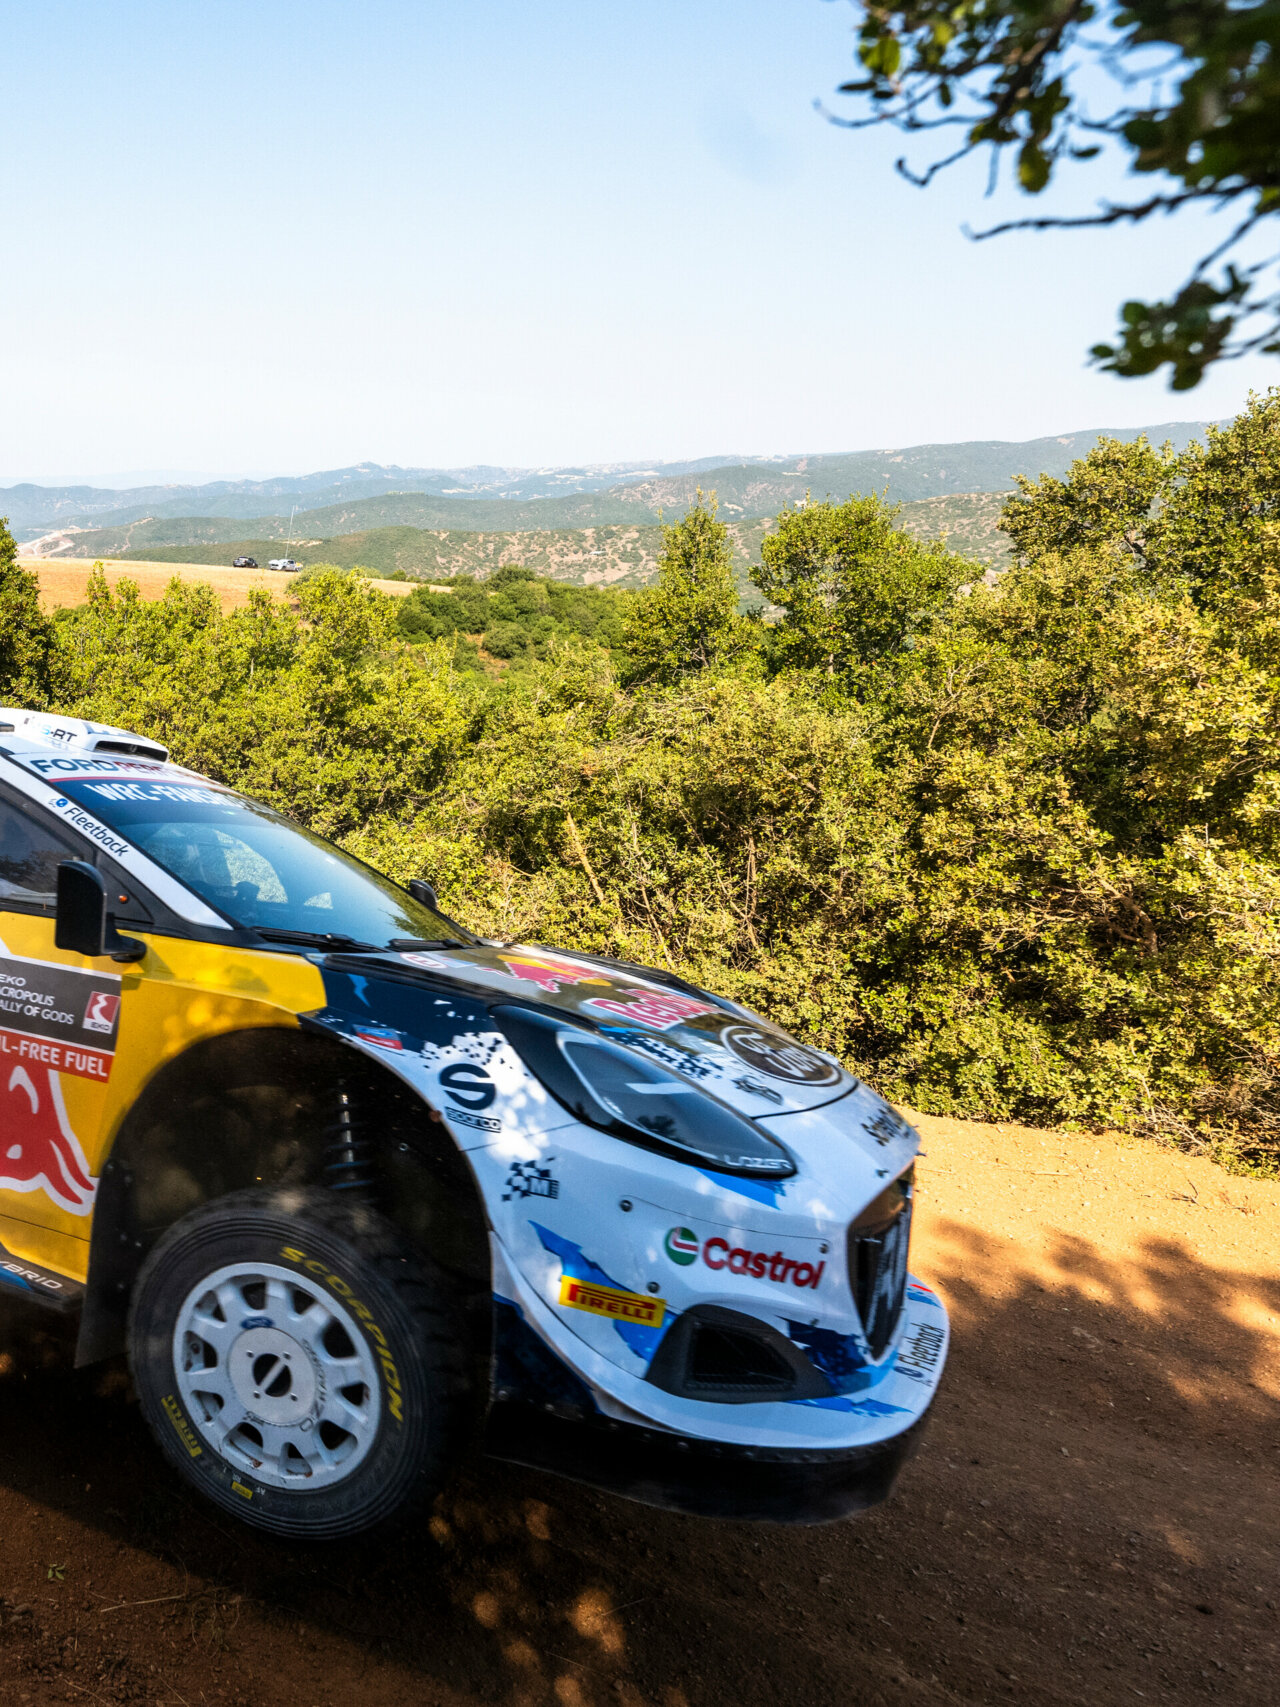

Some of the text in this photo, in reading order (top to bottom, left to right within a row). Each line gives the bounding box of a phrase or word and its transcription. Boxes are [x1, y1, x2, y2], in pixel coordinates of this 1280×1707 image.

[63, 806, 130, 858] Fleetback
[23, 1004, 41, 1017] OF
[40, 1008, 75, 1025] GODS
[64, 1050, 109, 1077] FUEL
[702, 1237, 827, 1290] Castrol
[567, 1283, 657, 1321] PIRELLI
[279, 1246, 404, 1423] SCORPION
[896, 1321, 947, 1373] Fleetback
